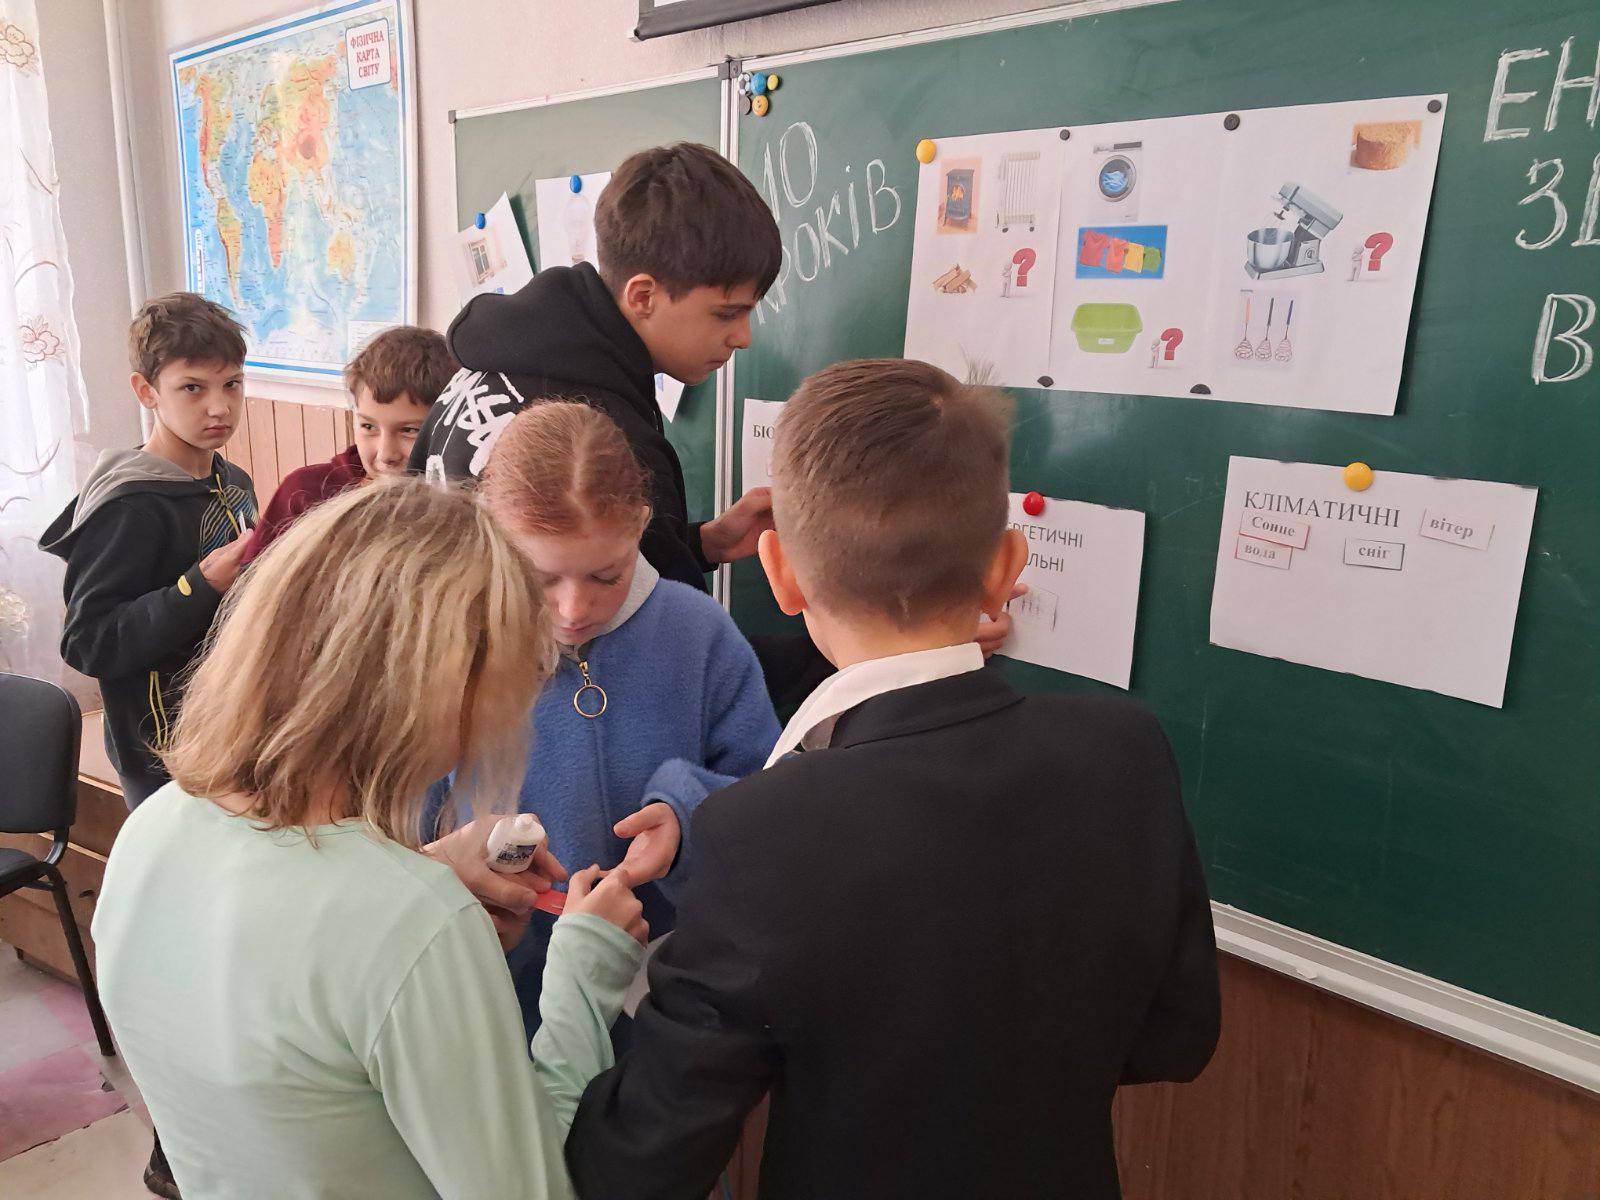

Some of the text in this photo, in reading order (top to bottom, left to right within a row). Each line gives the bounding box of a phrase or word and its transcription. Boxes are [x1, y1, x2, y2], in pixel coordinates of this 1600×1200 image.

[350, 30, 385, 49] ФІЗИЧНА
[356, 48, 380, 63] КАРТА
[358, 63, 380, 78] СВІТУ
[763, 121, 818, 222] 10
[1531, 293, 1597, 386] В
[1243, 490, 1401, 528] КЛІМАТИЧНІ
[1429, 517, 1474, 540] вітер
[1357, 544, 1391, 560] сніг
